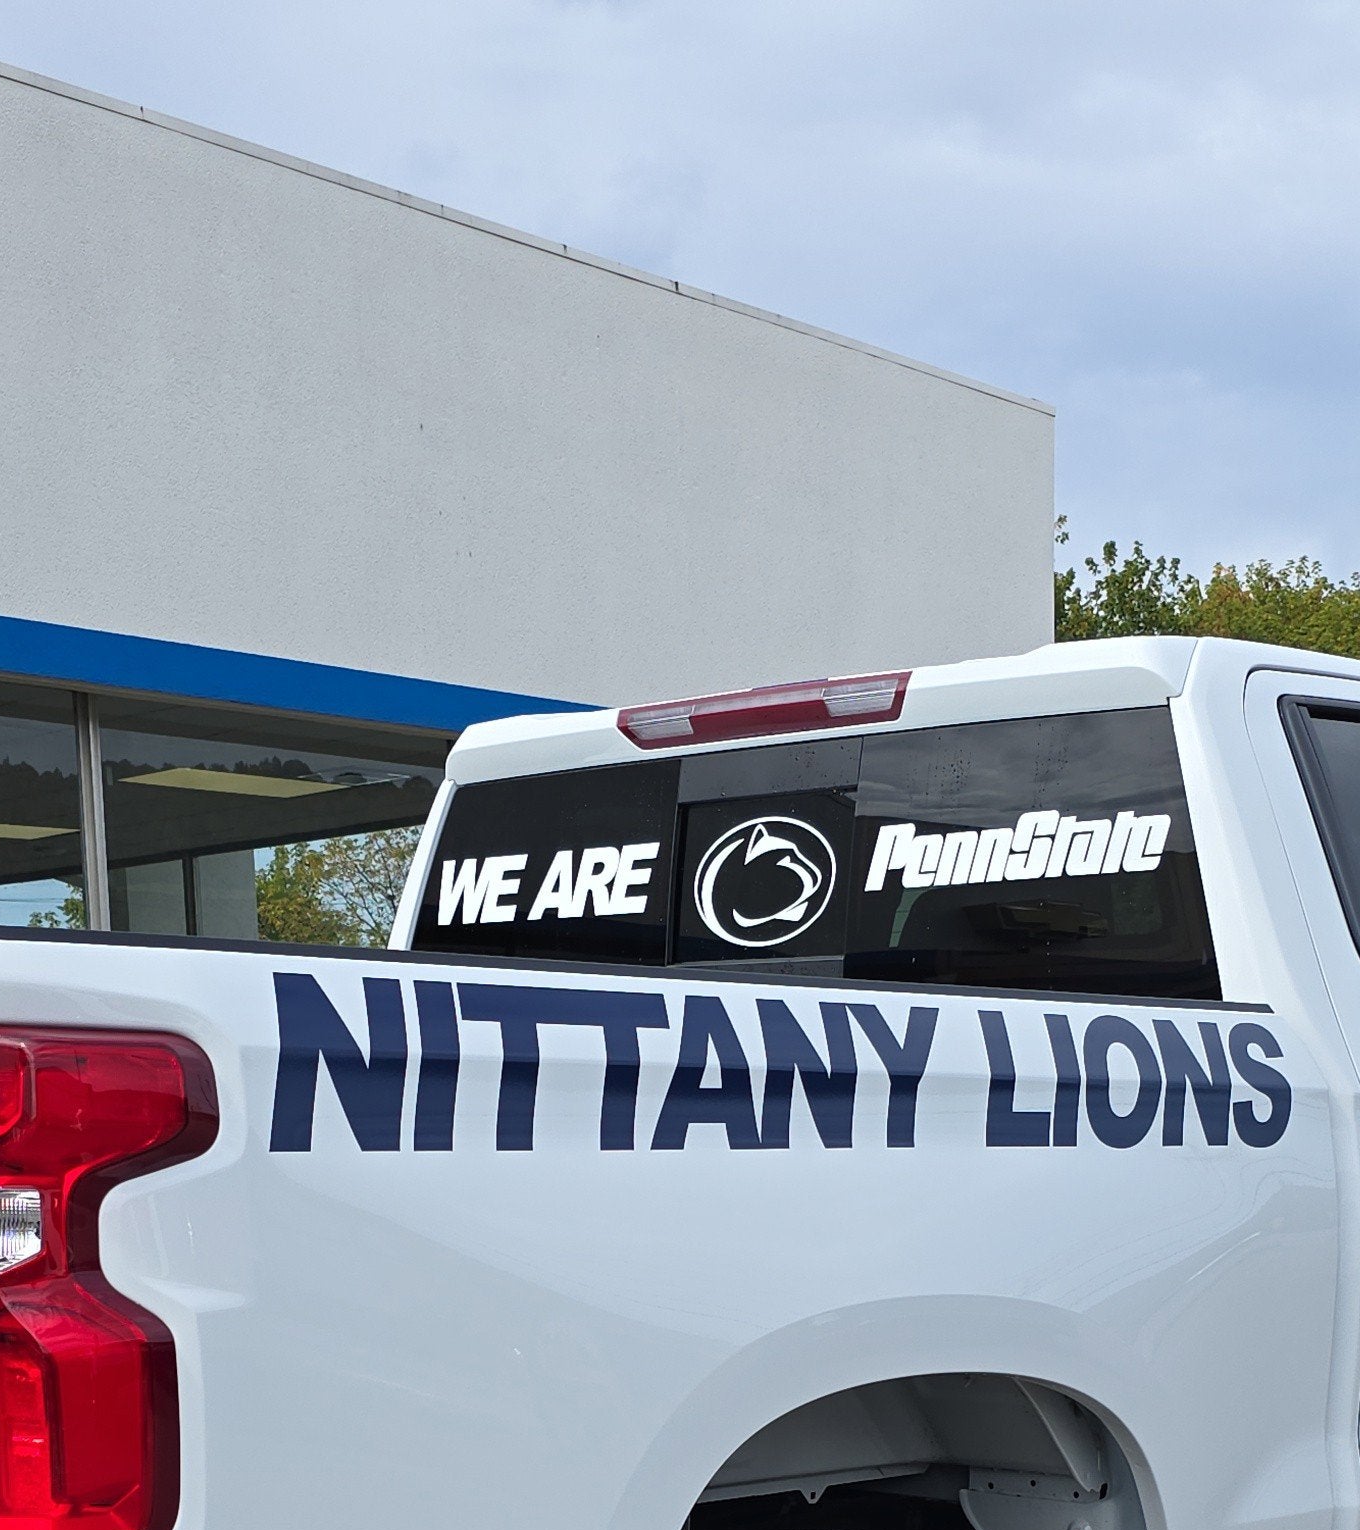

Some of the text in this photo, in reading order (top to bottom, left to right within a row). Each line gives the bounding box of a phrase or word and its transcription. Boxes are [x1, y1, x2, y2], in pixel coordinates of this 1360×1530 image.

[437, 841, 660, 926] WE ARE
[864, 809, 1171, 893] PennState
[268, 972, 1294, 1152] NITTANY LIONS
